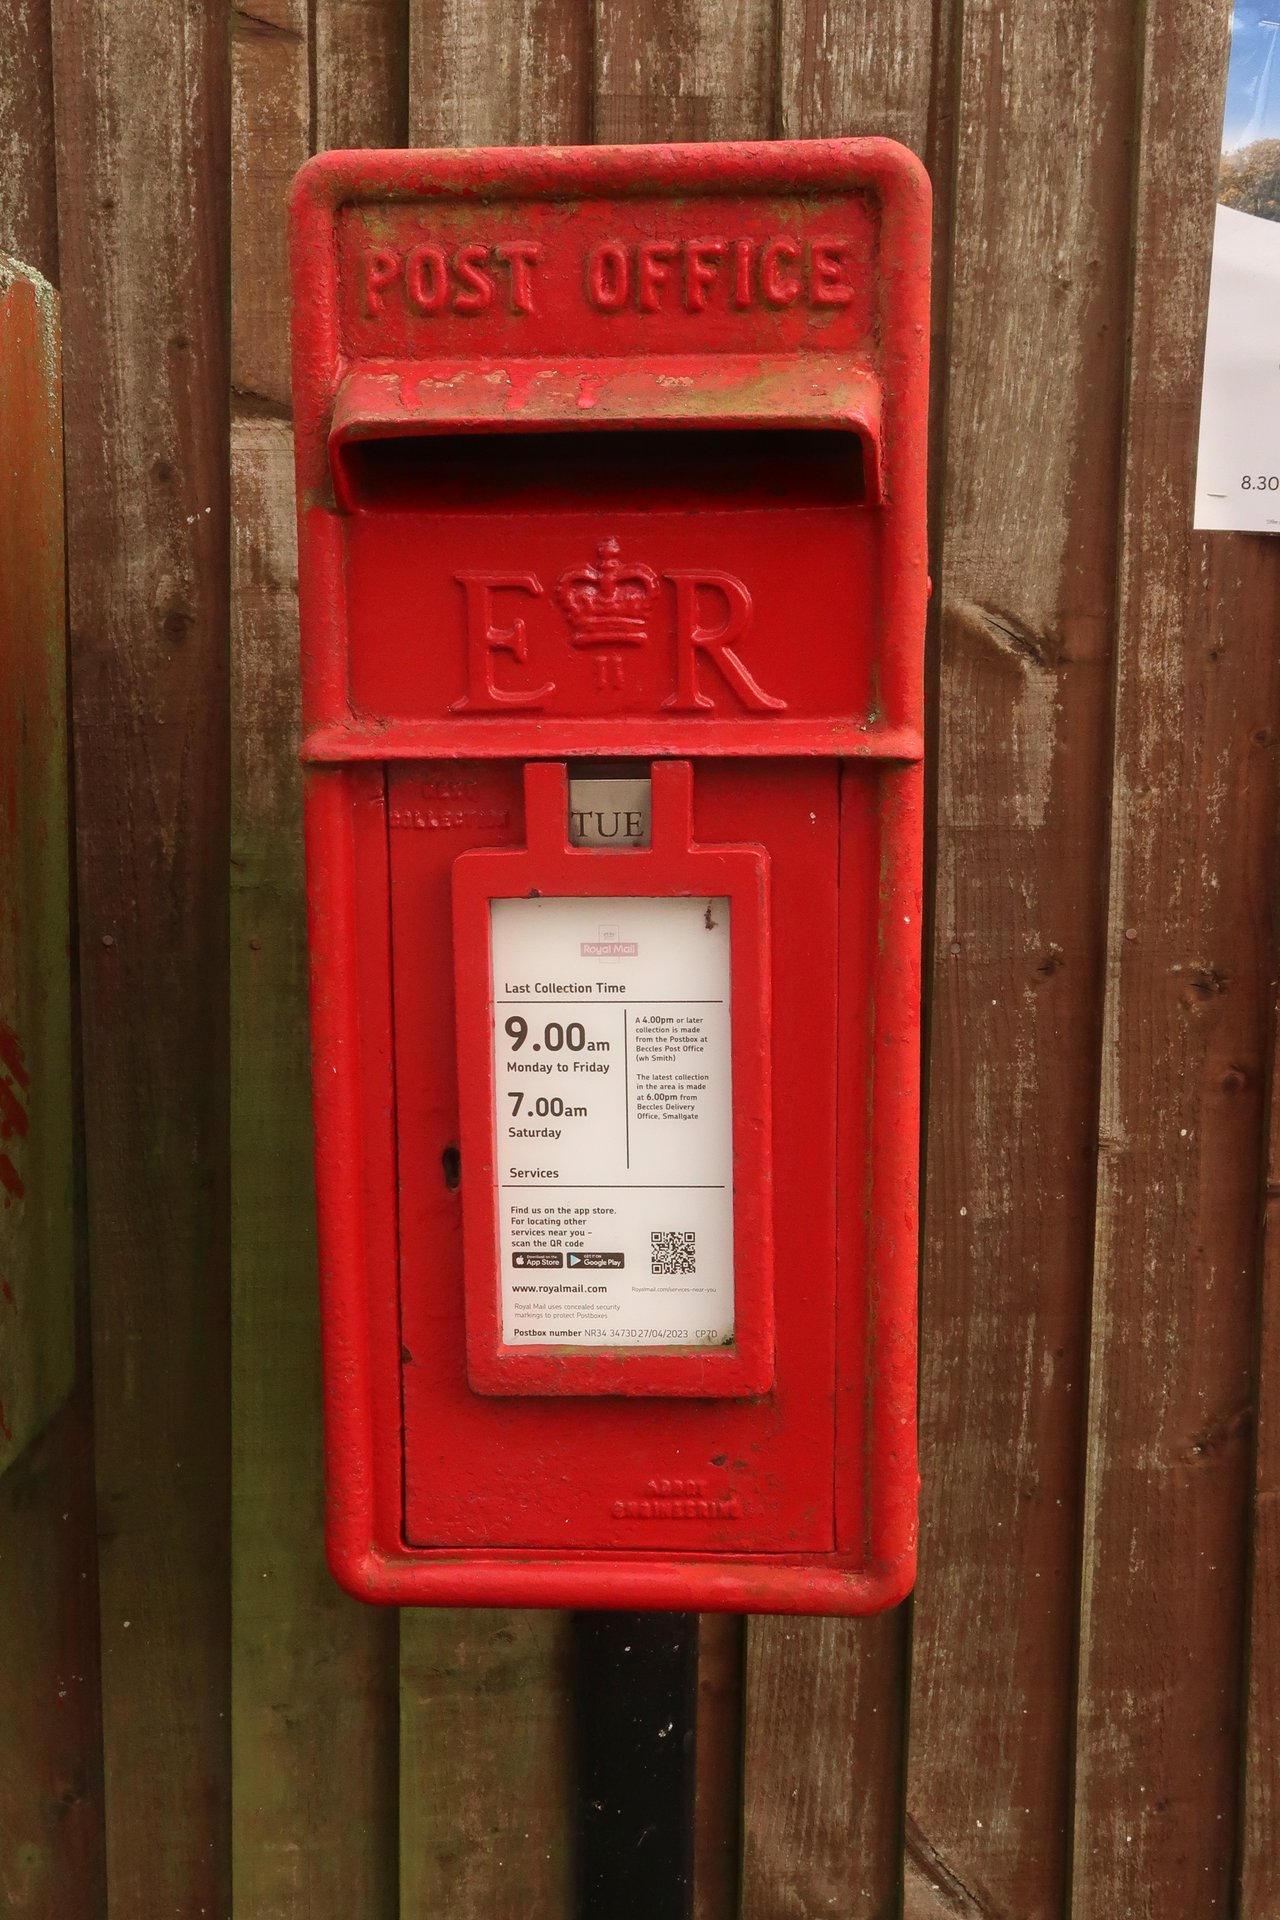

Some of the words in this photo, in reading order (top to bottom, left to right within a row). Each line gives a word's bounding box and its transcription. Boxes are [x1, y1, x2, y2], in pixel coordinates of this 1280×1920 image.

[364, 241, 542, 314] POST
[589, 239, 854, 311] OFFICE
[449, 570, 555, 711] E
[661, 568, 787, 709] R
[571, 811, 644, 837] TUE
[584, 945, 611, 955] Royal
[614, 945, 635, 953] Mail
[505, 983, 530, 993] Last
[535, 983, 592, 993] Collection
[596, 983, 626, 993] Time
[642, 1016, 673, 1025] 4.00pm
[504, 1016, 610, 1051] 9.00am
[507, 1062, 552, 1074] Monday
[557, 1063, 569, 1072] to
[573, 1062, 609, 1074] Friday
[647, 1093, 677, 1102] 6.00pm
[508, 1092, 587, 1117] 7.00am
[663, 1113, 698, 1121] Smallgate
[508, 1127, 561, 1139] Saturday
[510, 1168, 559, 1178] Services
[511, 1206, 528, 1214] Find
[574, 1208, 590, 1216] app
[527, 1218, 561, 1226] locating
[511, 1228, 545, 1236] services
[584, 1259, 607, 1267] Google
[608, 1259, 621, 1267] Play
[512, 1284, 607, 1294] www.royalmail.com
[514, 1303, 531, 1311] Royal
[585, 1329, 606, 1337] NR34
[638, 1329, 688, 1338] 27/04/2023
